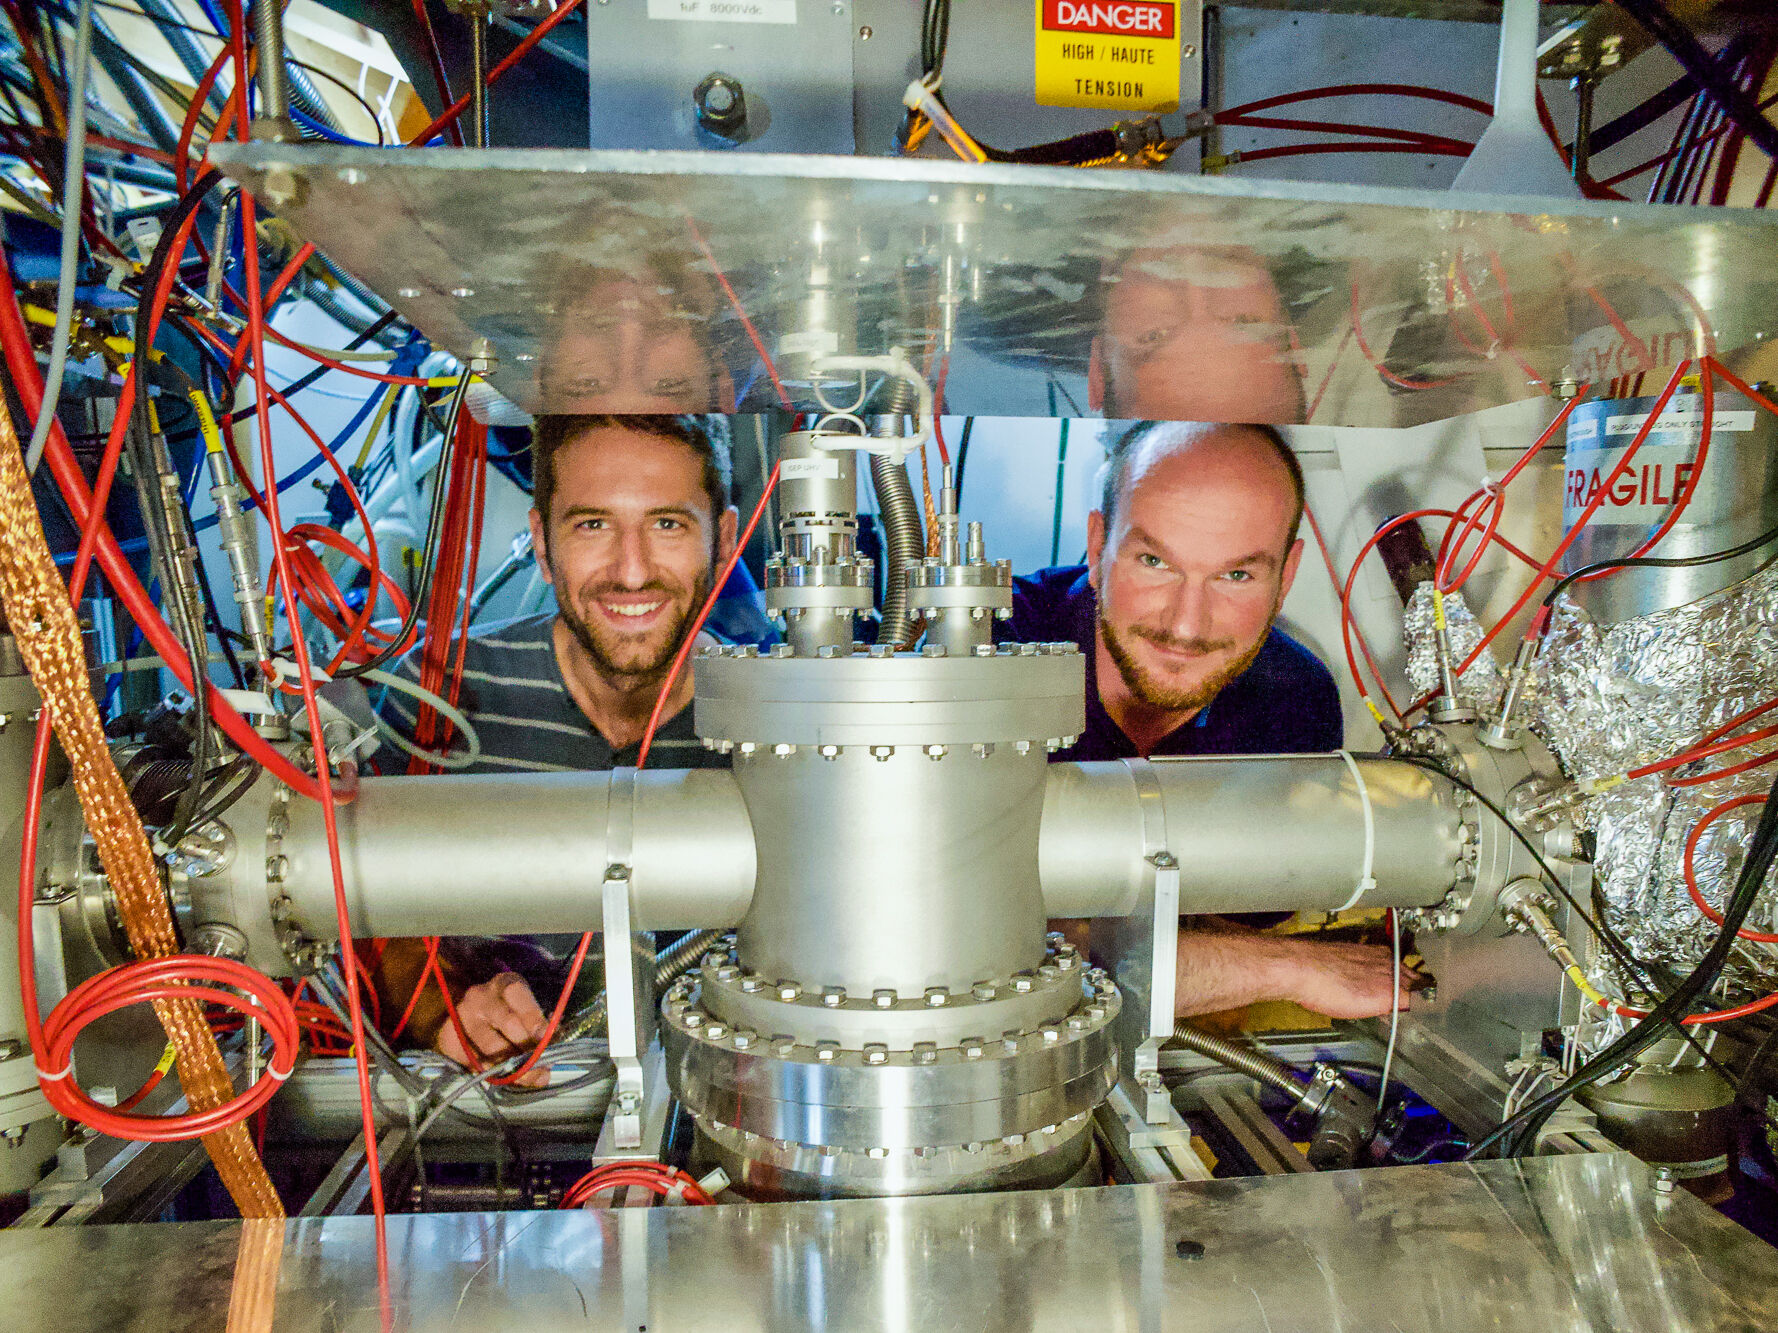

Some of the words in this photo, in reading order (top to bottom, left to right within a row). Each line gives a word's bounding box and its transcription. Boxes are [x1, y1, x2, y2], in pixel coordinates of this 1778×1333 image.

[1057, 0, 1163, 32] DANGER
[1062, 43, 1095, 61] HIGH
[1100, 46, 1106, 61] /
[1111, 46, 1155, 65] HAUTE
[1075, 78, 1145, 98] TENSION
[1566, 463, 1694, 508] FRAGILE
